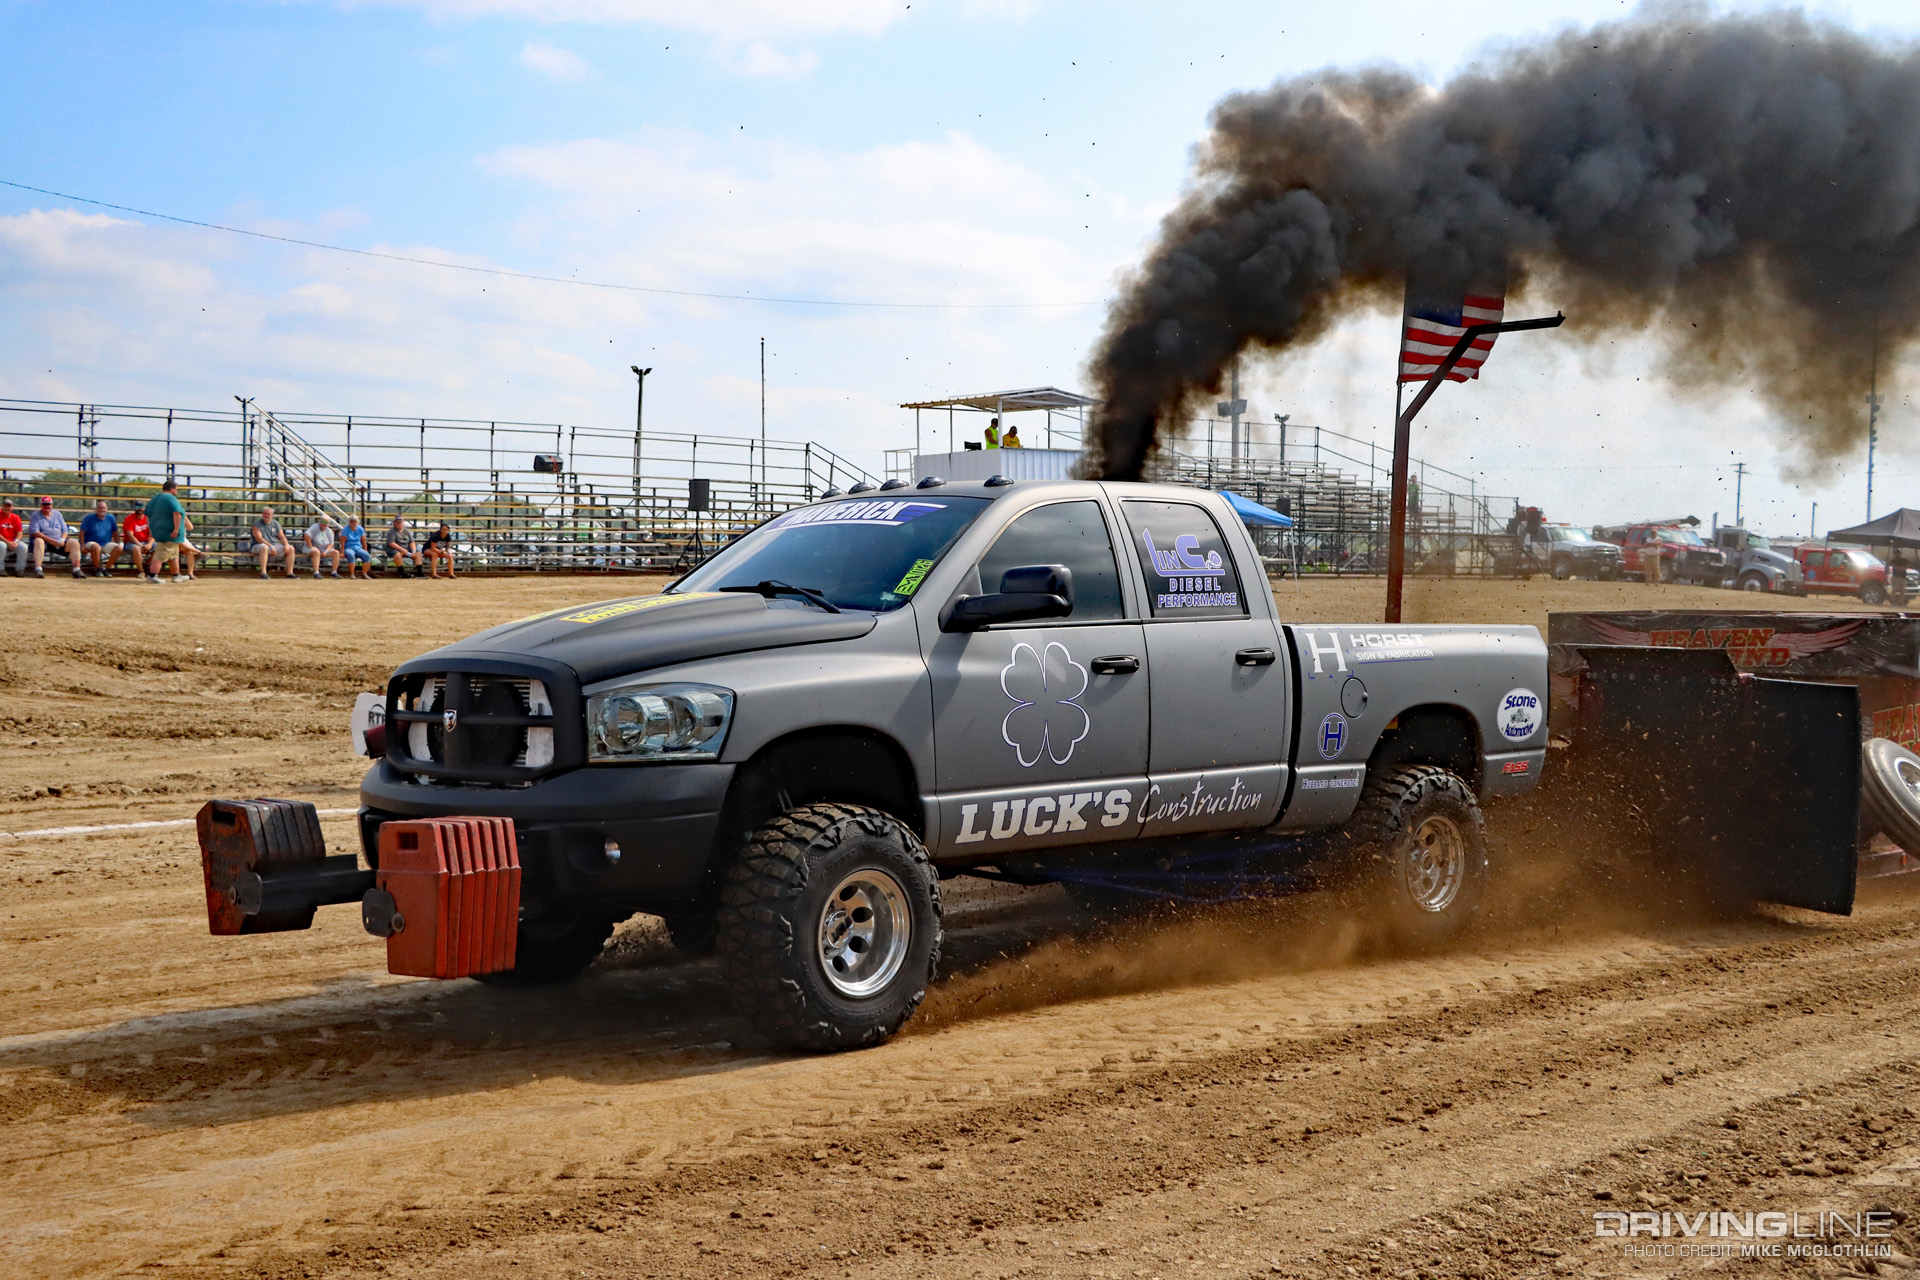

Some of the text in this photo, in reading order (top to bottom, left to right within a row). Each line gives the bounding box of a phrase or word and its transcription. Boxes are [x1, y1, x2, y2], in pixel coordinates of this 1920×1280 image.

[779, 501, 906, 528] MAVERICK
[1169, 577, 1222, 592] DIESEL
[1157, 592, 1238, 608] PERFORMANCE
[1349, 633, 1424, 648] HORST
[1649, 627, 1776, 650] HEAVEN
[1304, 632, 1349, 674] H
[1356, 648, 1435, 661] SIGN & FABRICATION
[1504, 694, 1537, 710] Stone
[1501, 760, 1531, 774] FASS
[954, 776, 1263, 844] LUCK'S Construction
